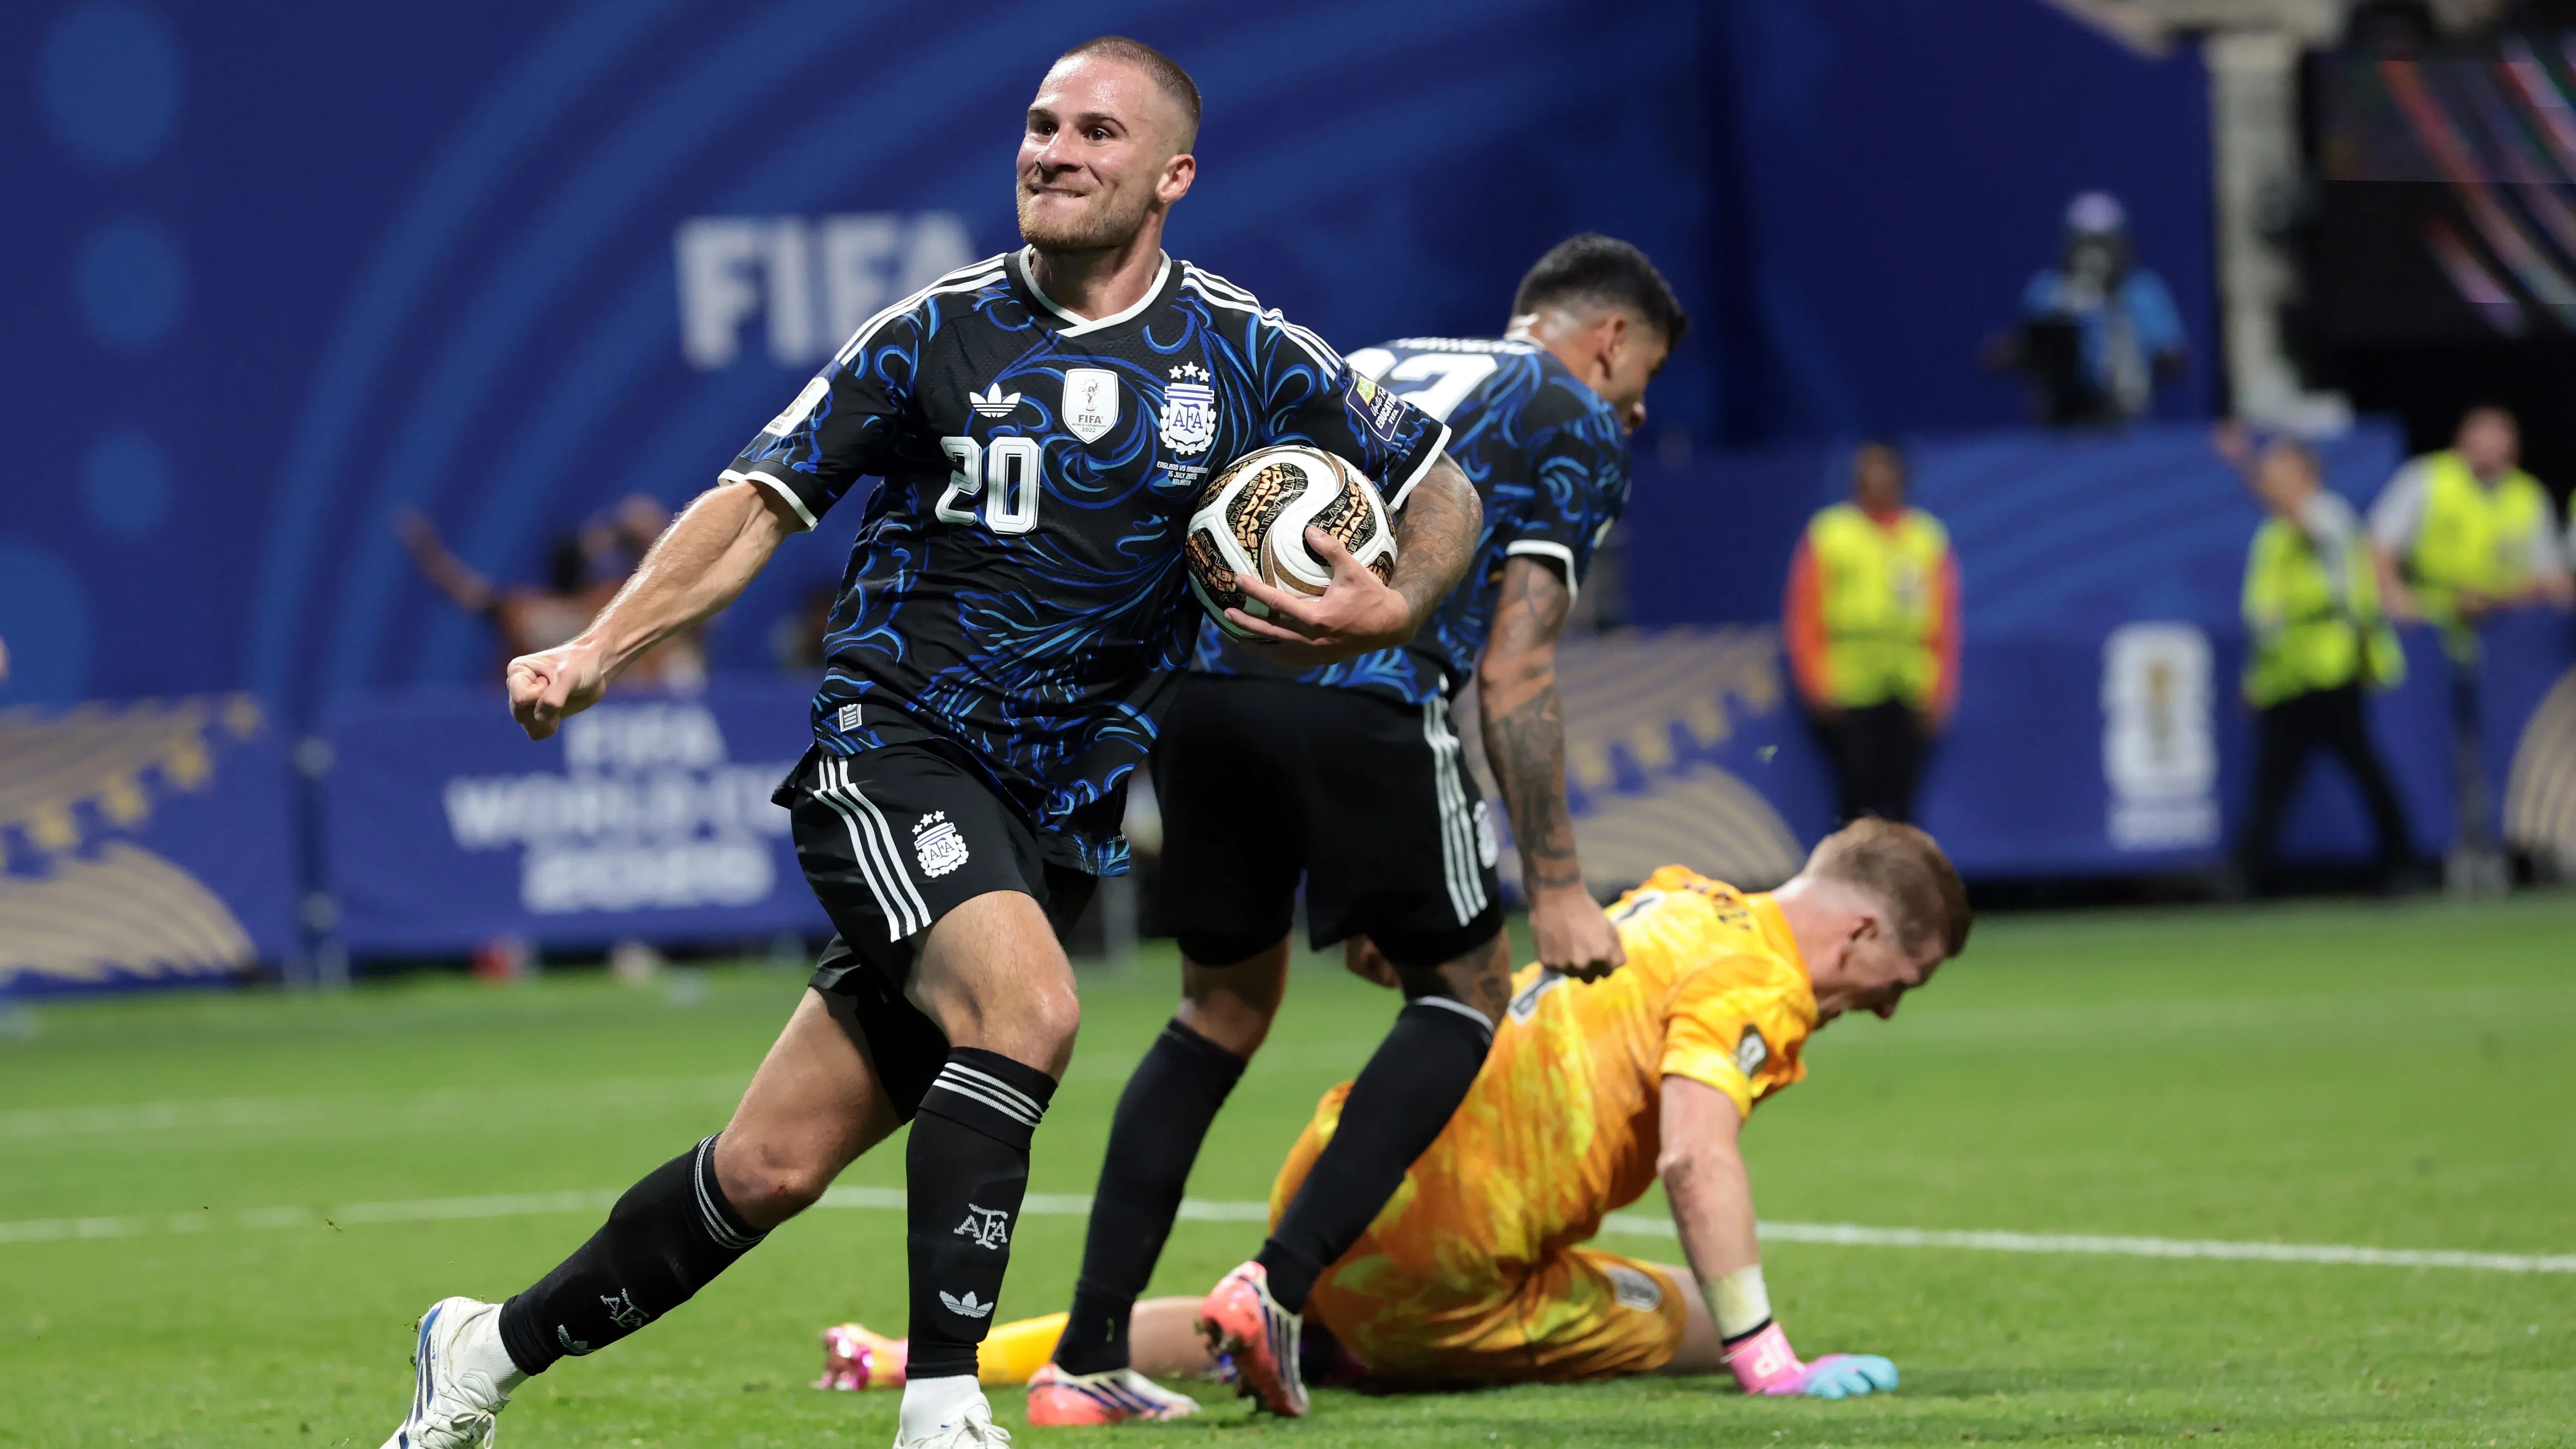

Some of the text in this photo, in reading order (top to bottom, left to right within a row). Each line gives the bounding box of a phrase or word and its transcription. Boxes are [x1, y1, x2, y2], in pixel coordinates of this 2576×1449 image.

[1078, 415, 1102, 424] FIFA
[1375, 391, 1397, 430] EDUCATIO
[1388, 409, 1399, 424] FIFA
[1156, 461, 1179, 471] ENGLAND
[1172, 478, 1192, 486] ATLANTA
[935, 436, 1041, 535] 20
[1247, 470, 1284, 548] DALLAS
[1317, 496, 1348, 534] TLAN
[1329, 482, 1361, 538] ALLAS
